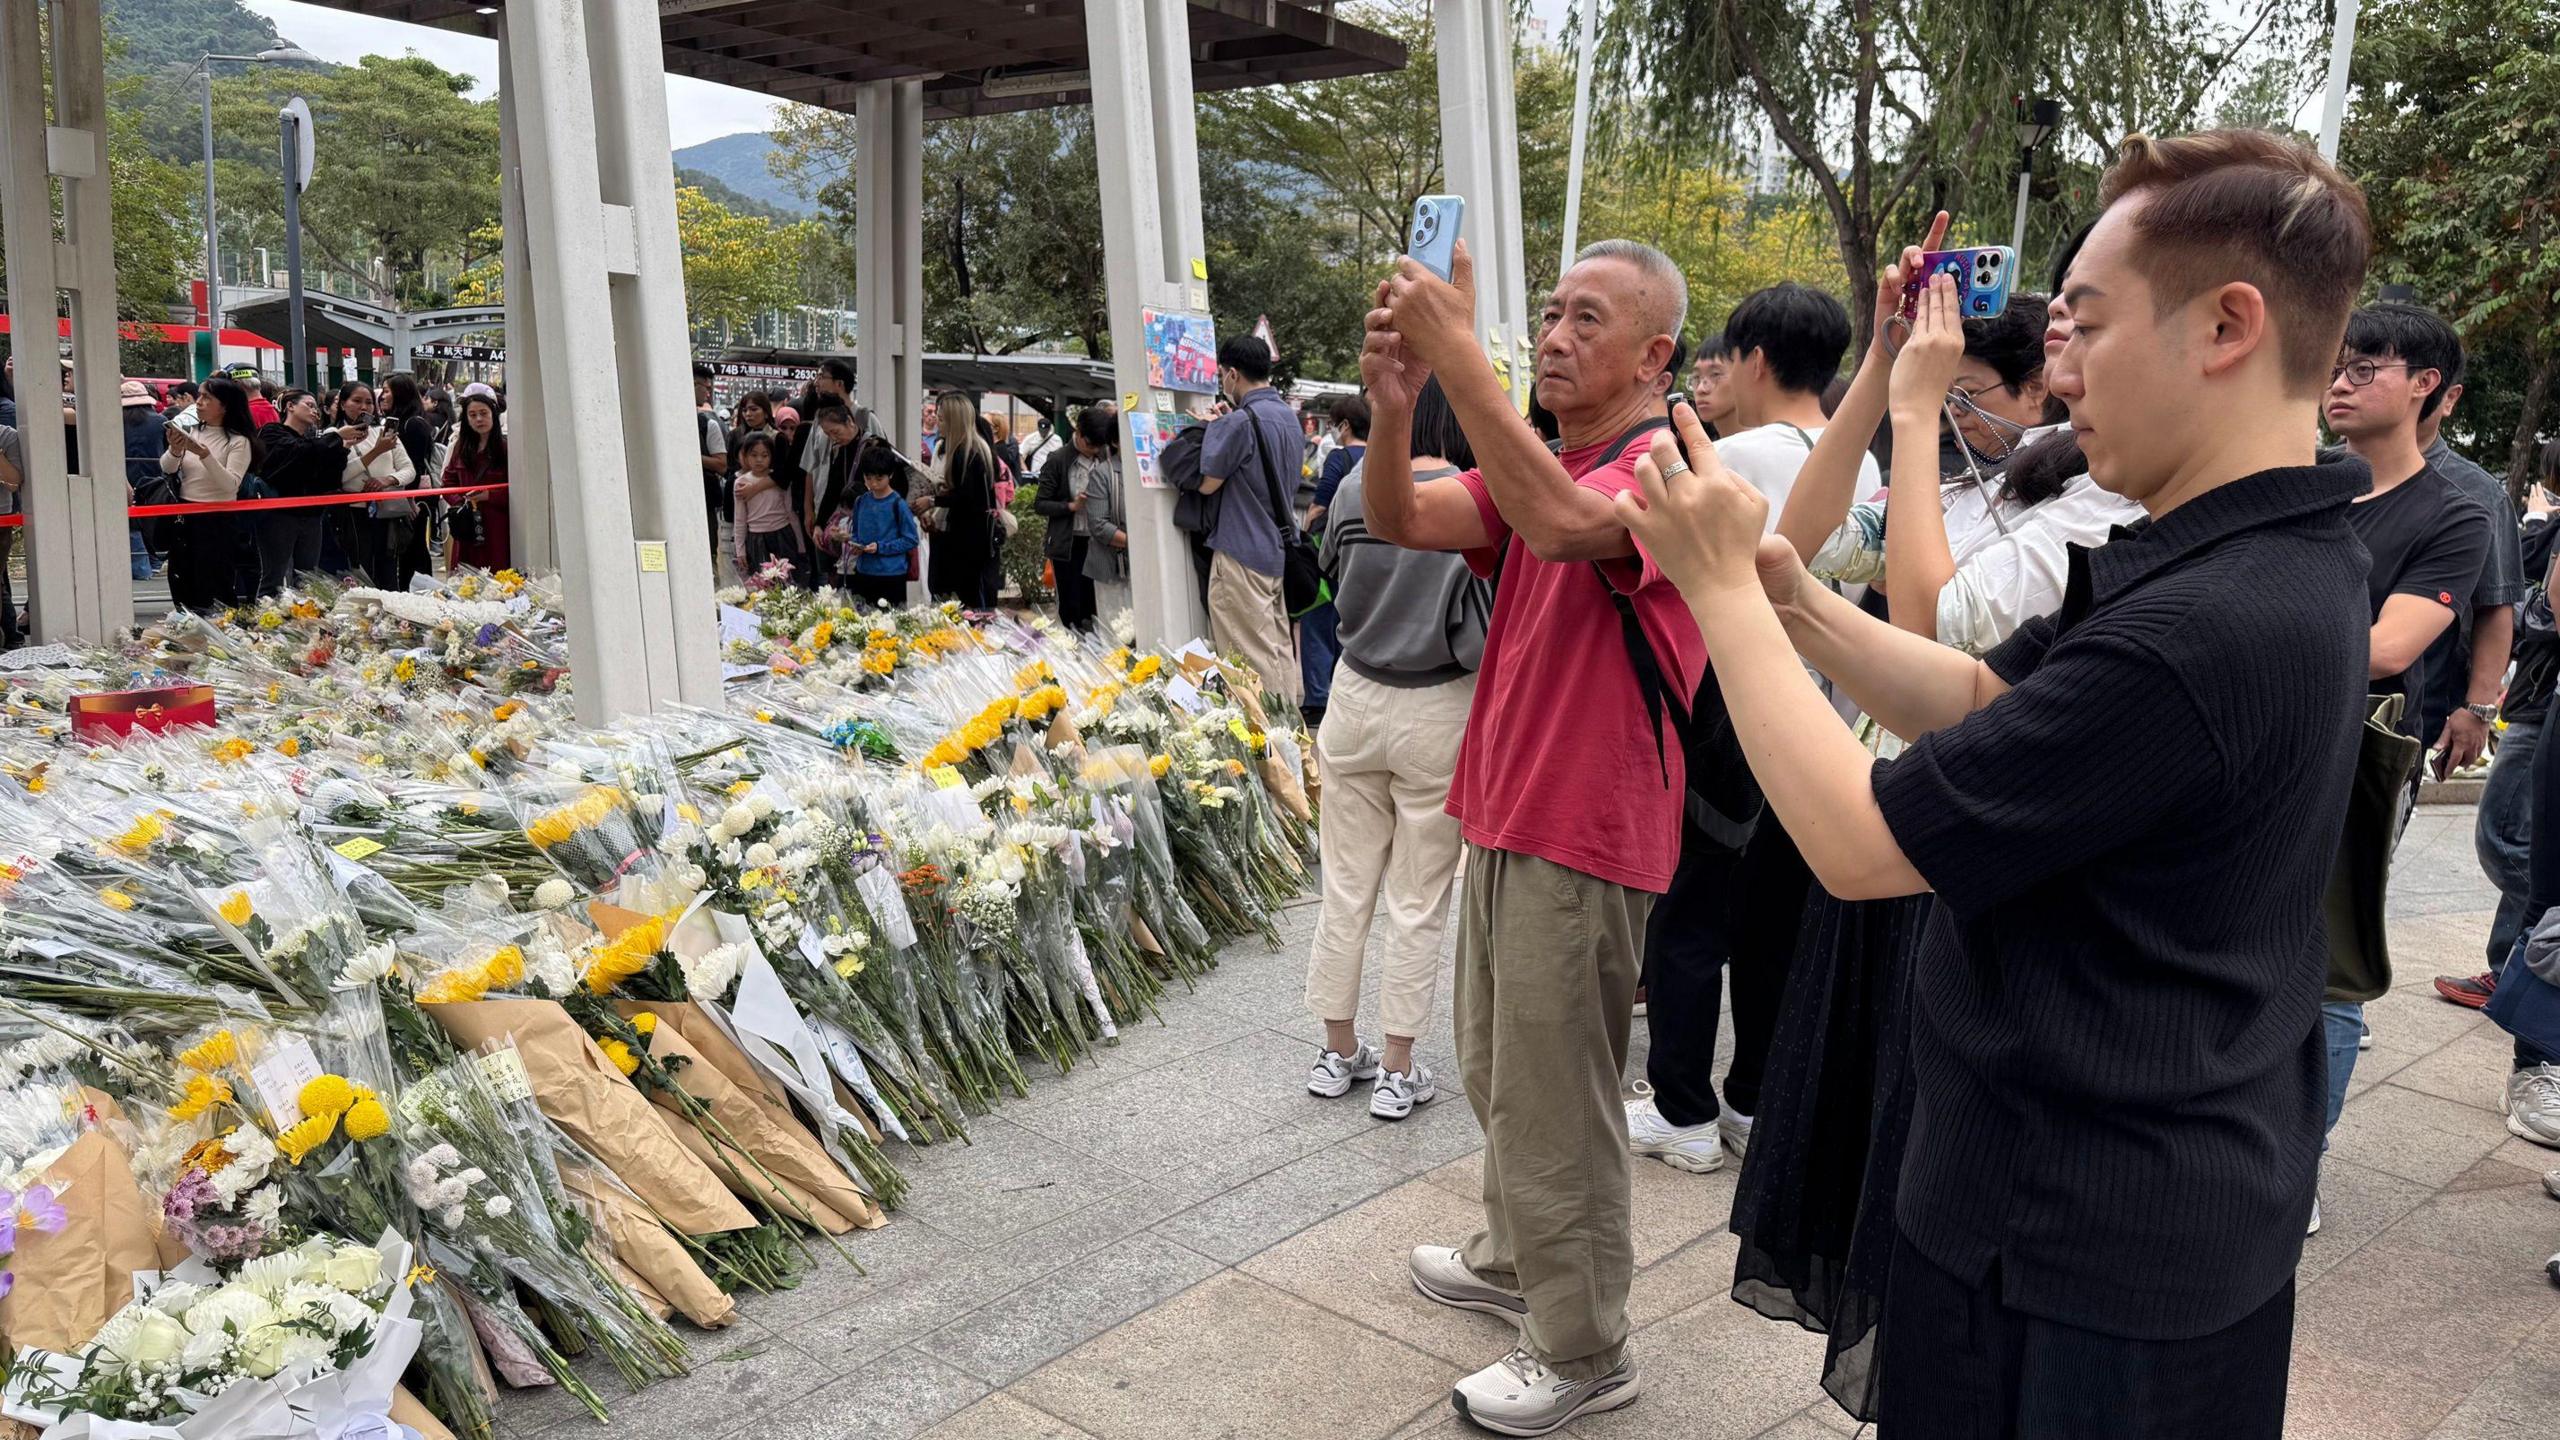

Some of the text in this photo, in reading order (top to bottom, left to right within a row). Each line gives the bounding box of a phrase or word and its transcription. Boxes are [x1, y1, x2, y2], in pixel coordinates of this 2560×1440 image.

[443, 346, 473, 358] 航天城
[489, 350, 506, 361] A4
[720, 364, 739, 375] 74B
